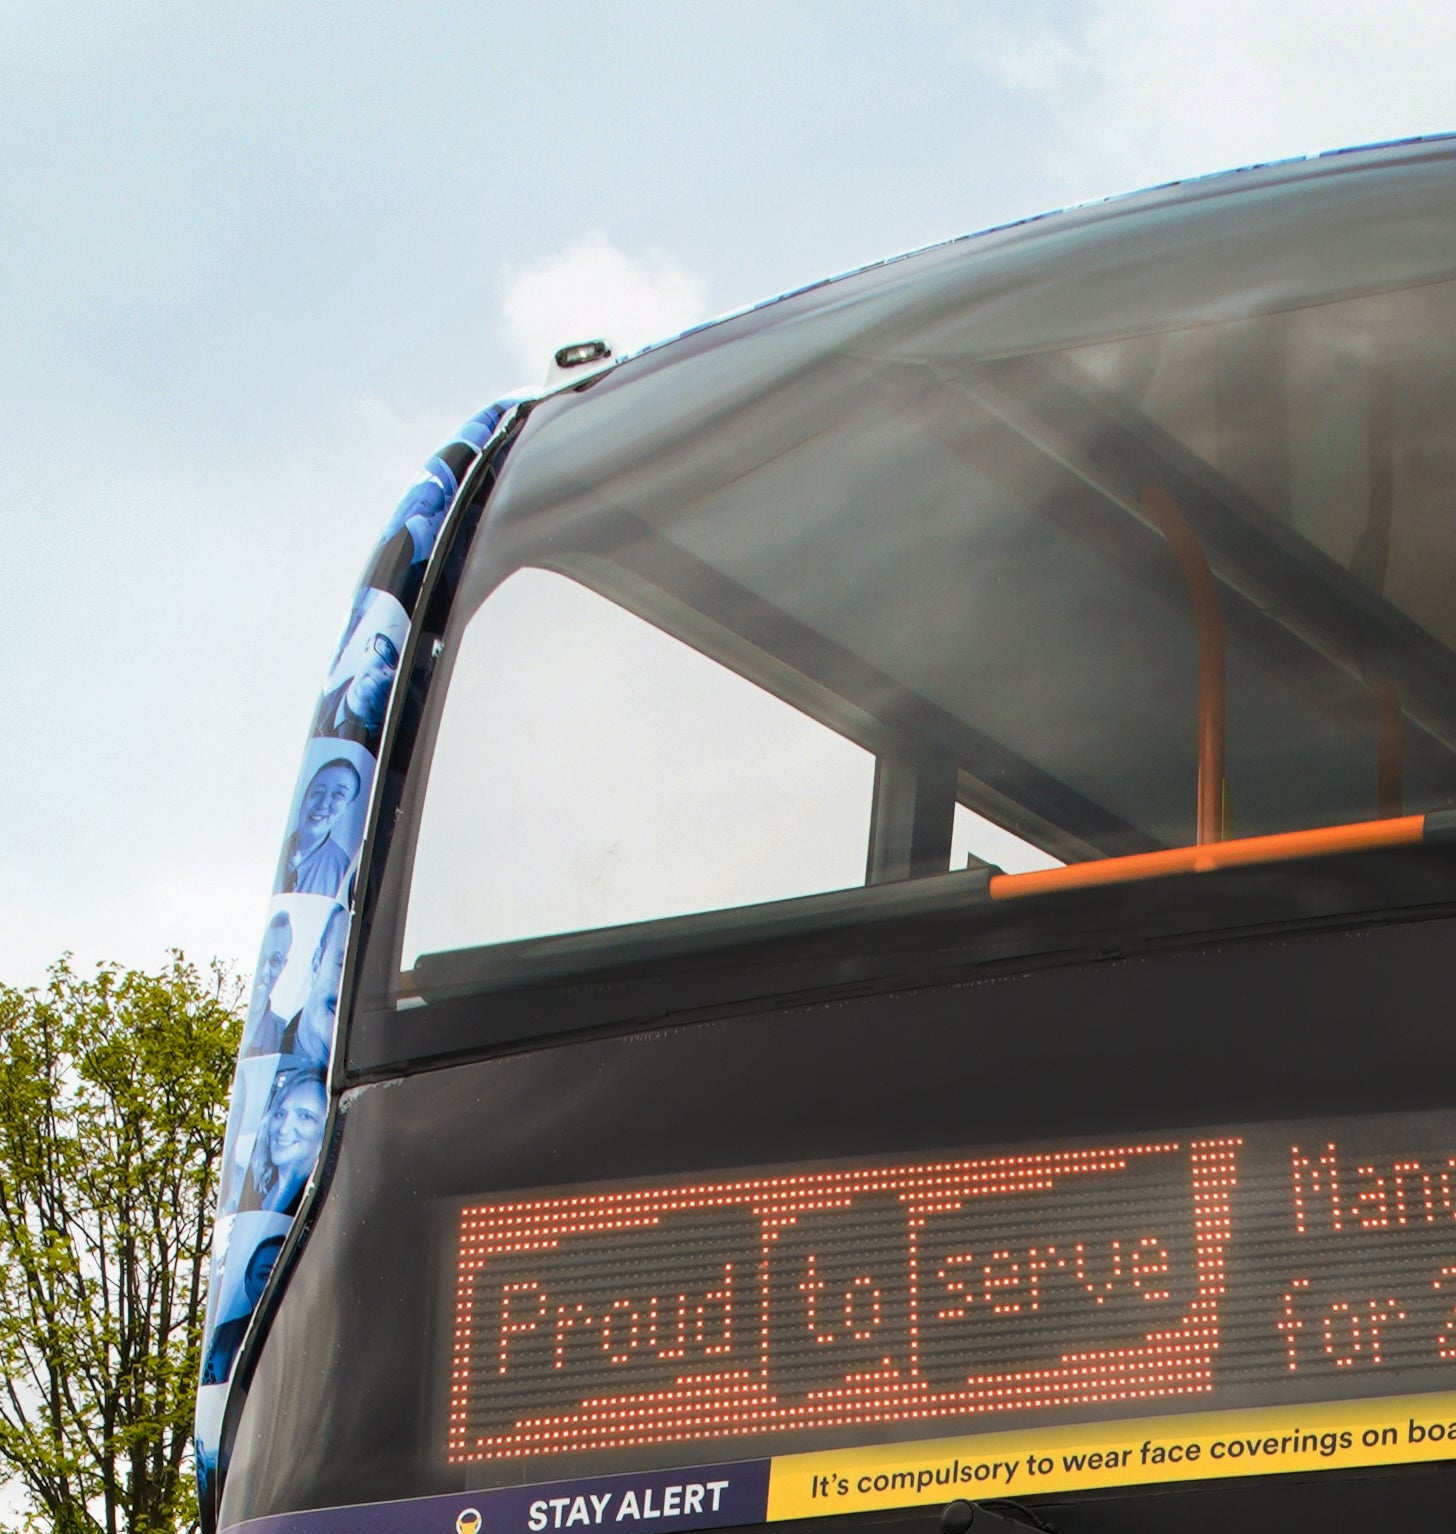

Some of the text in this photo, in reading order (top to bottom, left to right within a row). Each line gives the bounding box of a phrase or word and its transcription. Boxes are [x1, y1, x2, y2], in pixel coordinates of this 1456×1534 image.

[497, 1235, 1171, 1375] Proud to serve
[1276, 1276, 1409, 1372] for
[856, 1459, 1020, 1492] compulsory
[1025, 1454, 1055, 1476] to
[1061, 1448, 1133, 1472] wear
[1140, 1440, 1202, 1465] face
[1209, 1427, 1353, 1457] coverings
[1361, 1427, 1399, 1448] on
[527, 1478, 730, 1534] STAY ALERT
